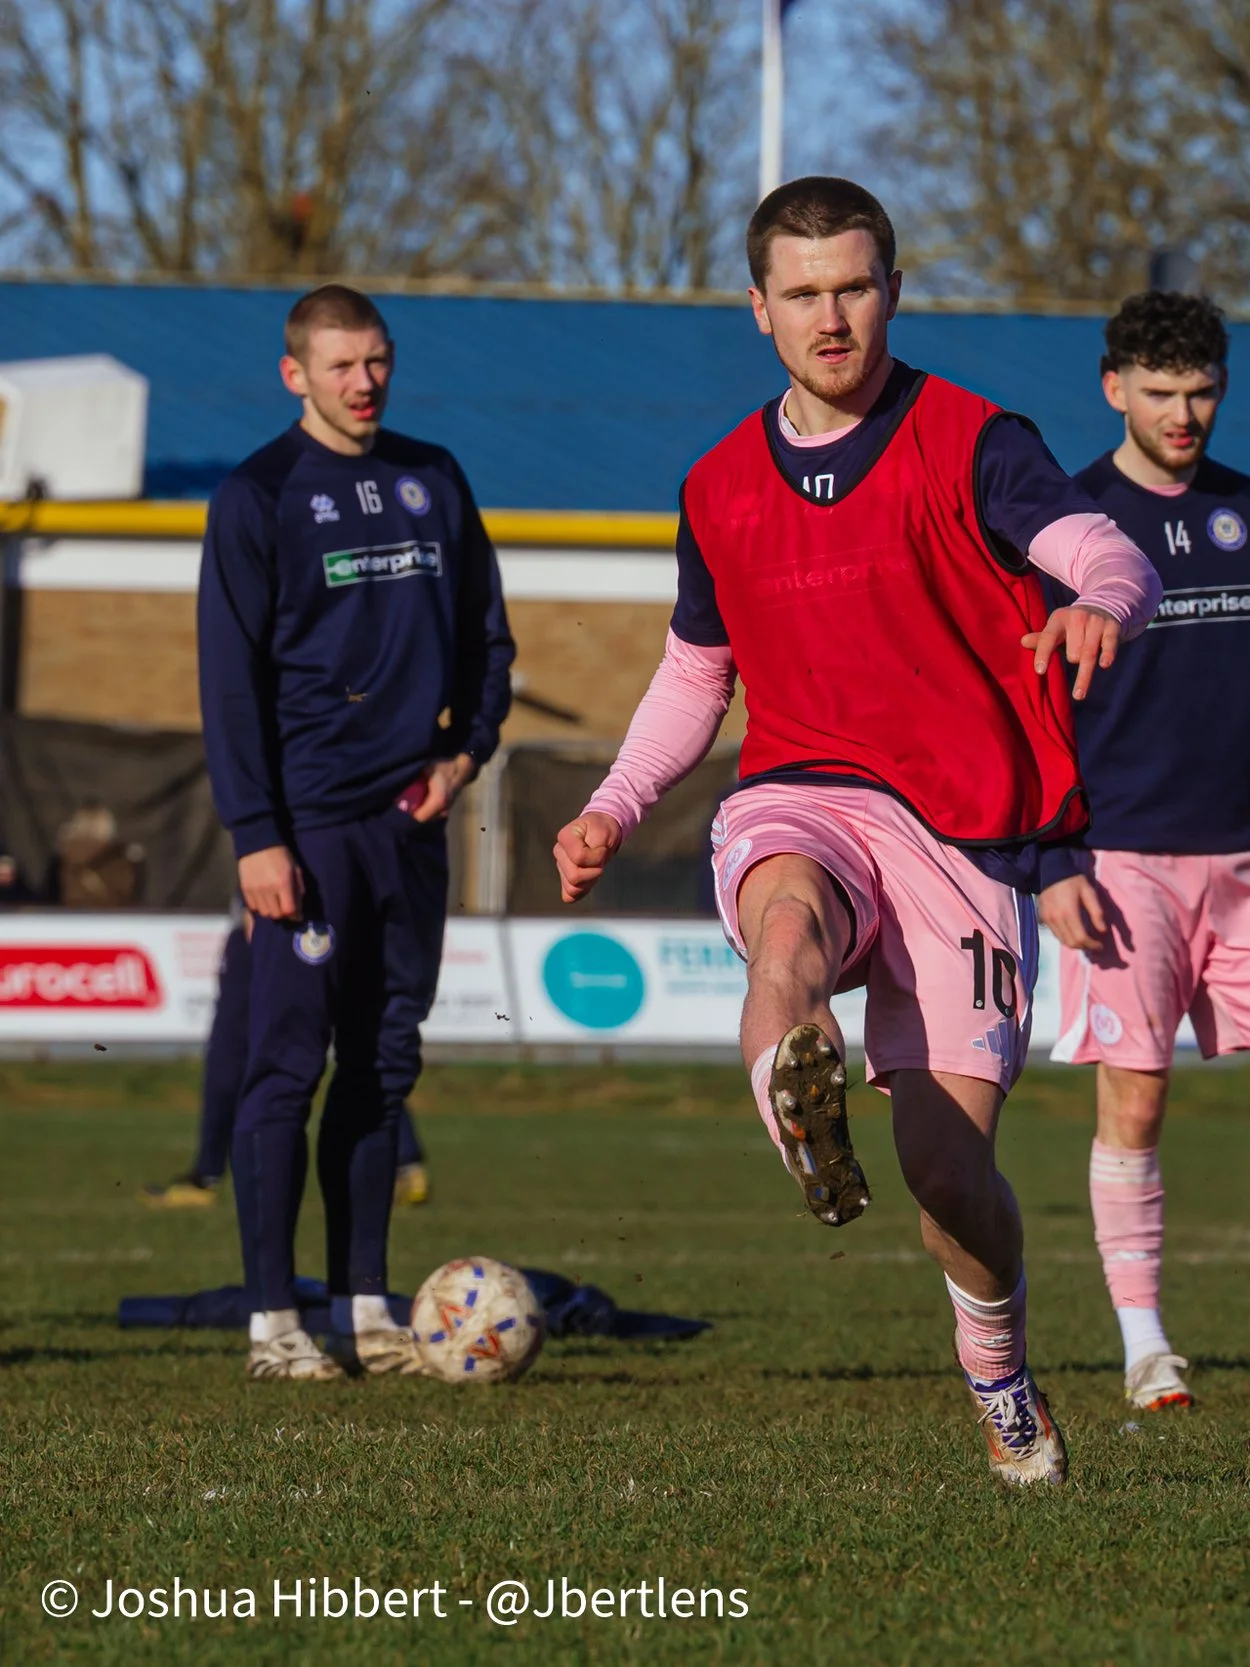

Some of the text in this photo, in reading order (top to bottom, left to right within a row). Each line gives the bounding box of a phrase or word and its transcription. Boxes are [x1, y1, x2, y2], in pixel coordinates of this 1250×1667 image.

[356, 480, 383, 515] 16
[1164, 520, 1191, 556] 14
[961, 929, 1017, 1018] 10
